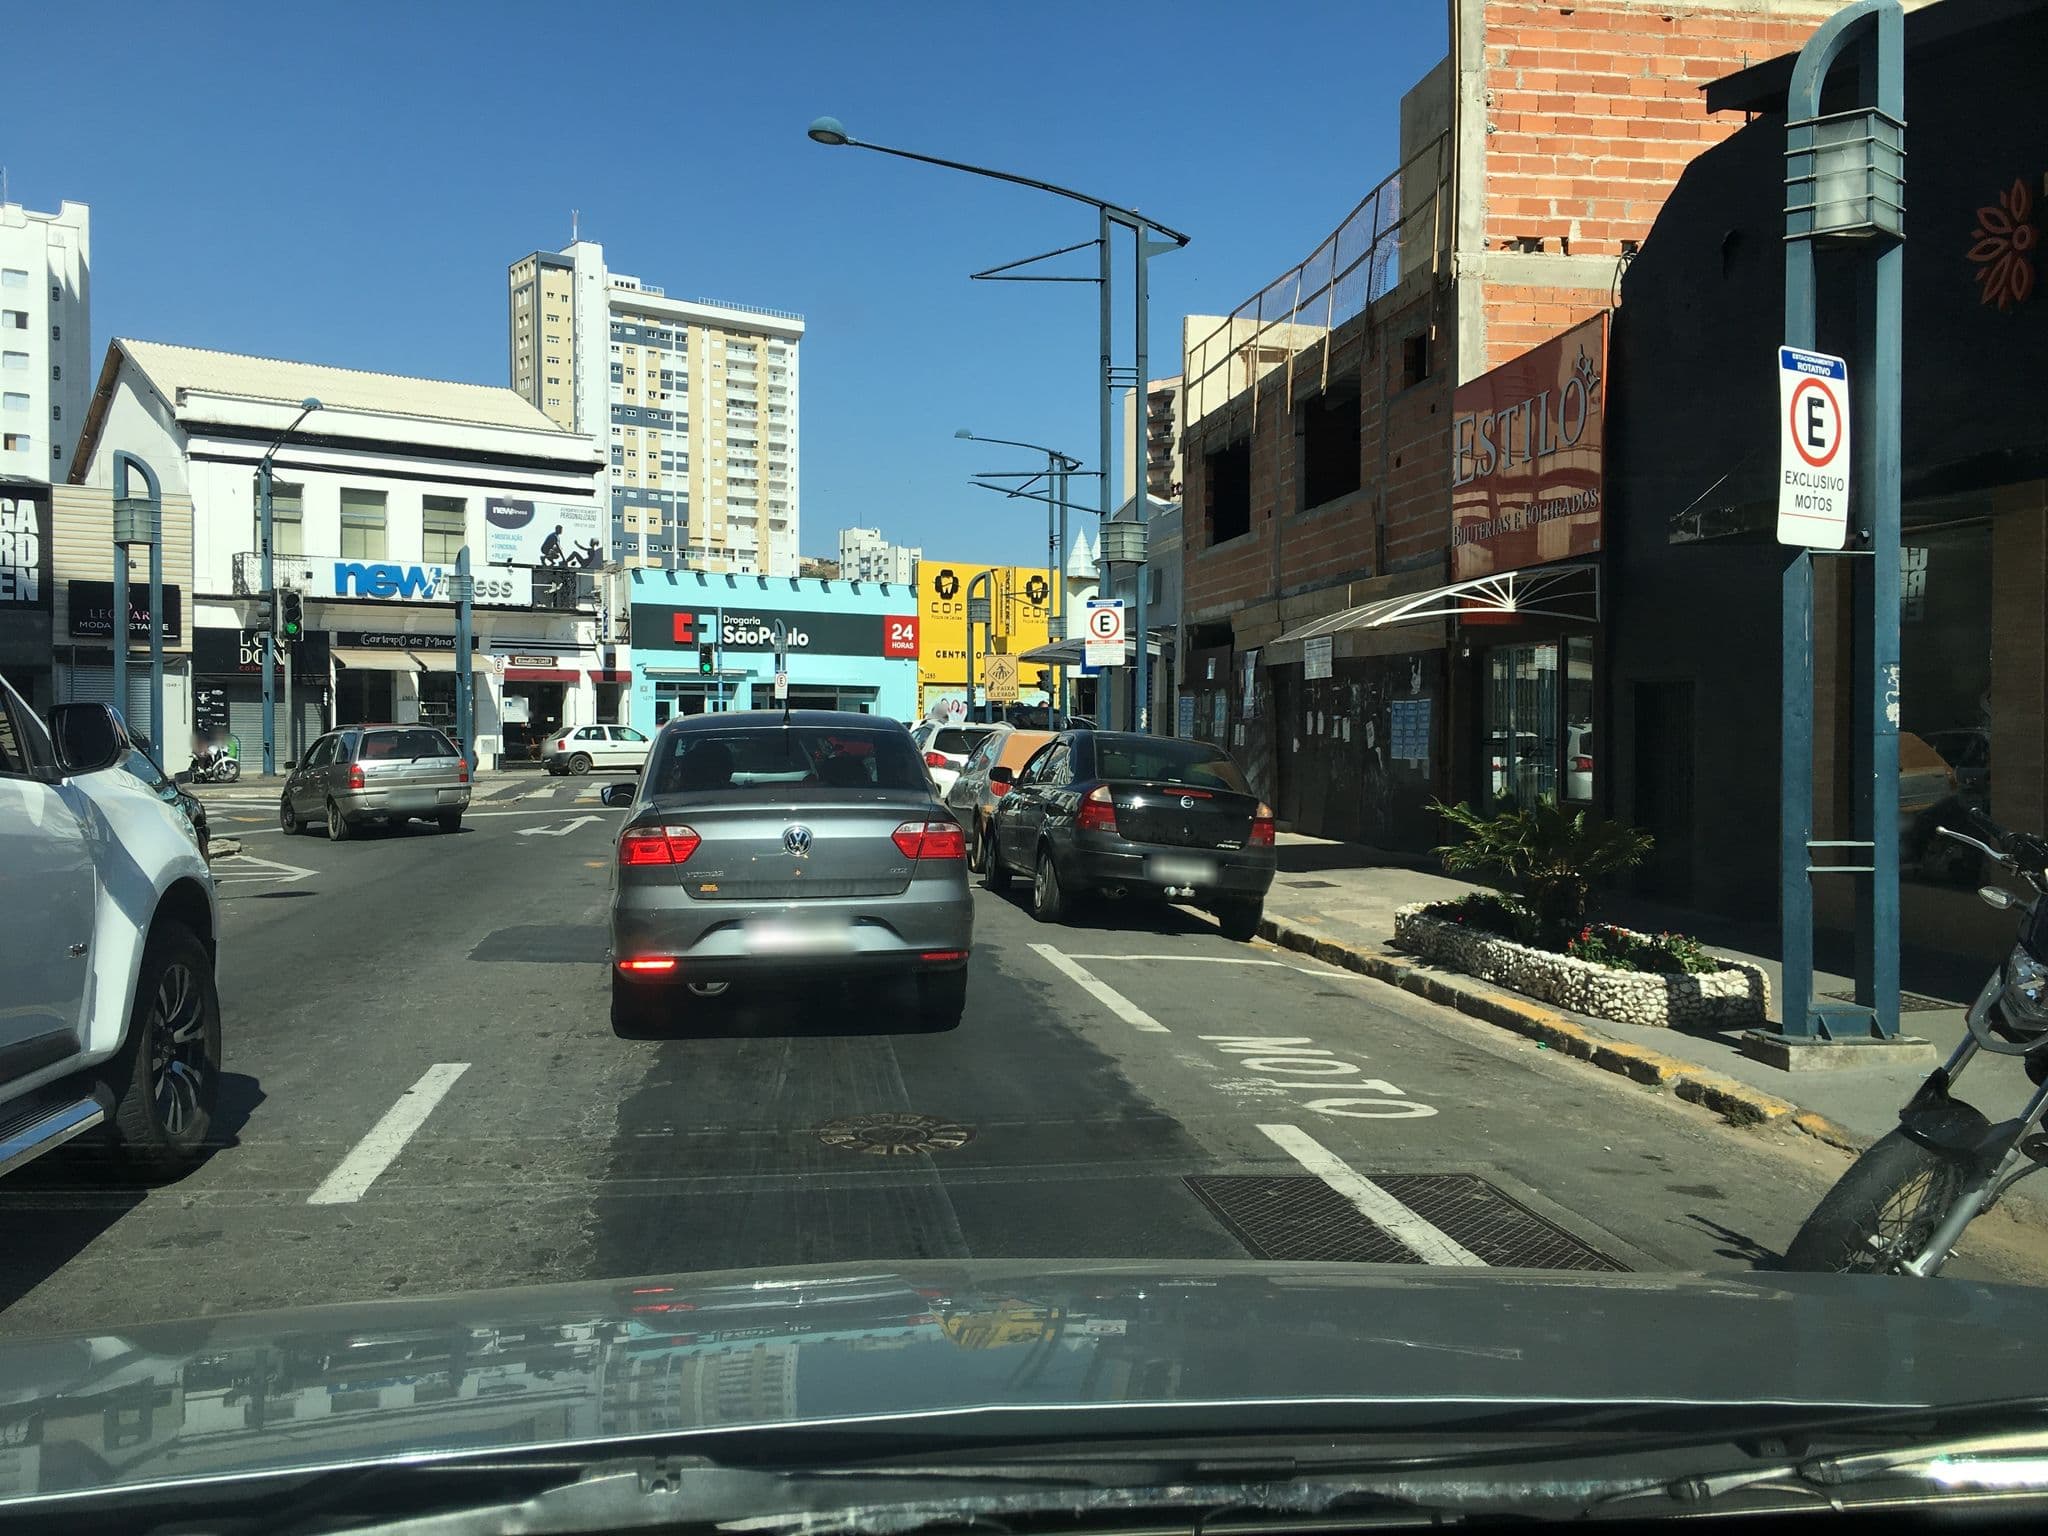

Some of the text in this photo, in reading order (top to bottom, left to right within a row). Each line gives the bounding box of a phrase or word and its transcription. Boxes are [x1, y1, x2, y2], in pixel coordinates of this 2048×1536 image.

[1797, 363, 1831, 376] ROTATIVO
[1807, 396, 1825, 448] E
[1453, 377, 1587, 488] ESTILO
[1785, 470, 1844, 492] EXCLUSIVO
[1524, 488, 1599, 529] FOLHEADOS
[1795, 494, 1832, 512] MOTOS
[931, 602, 962, 614] COP
[723, 615, 761, 627] Drogaria
[1100, 615, 1111, 632] E
[891, 623, 914, 640] 24
[410, 636, 422, 645] de
[891, 642, 914, 650] HORAS
